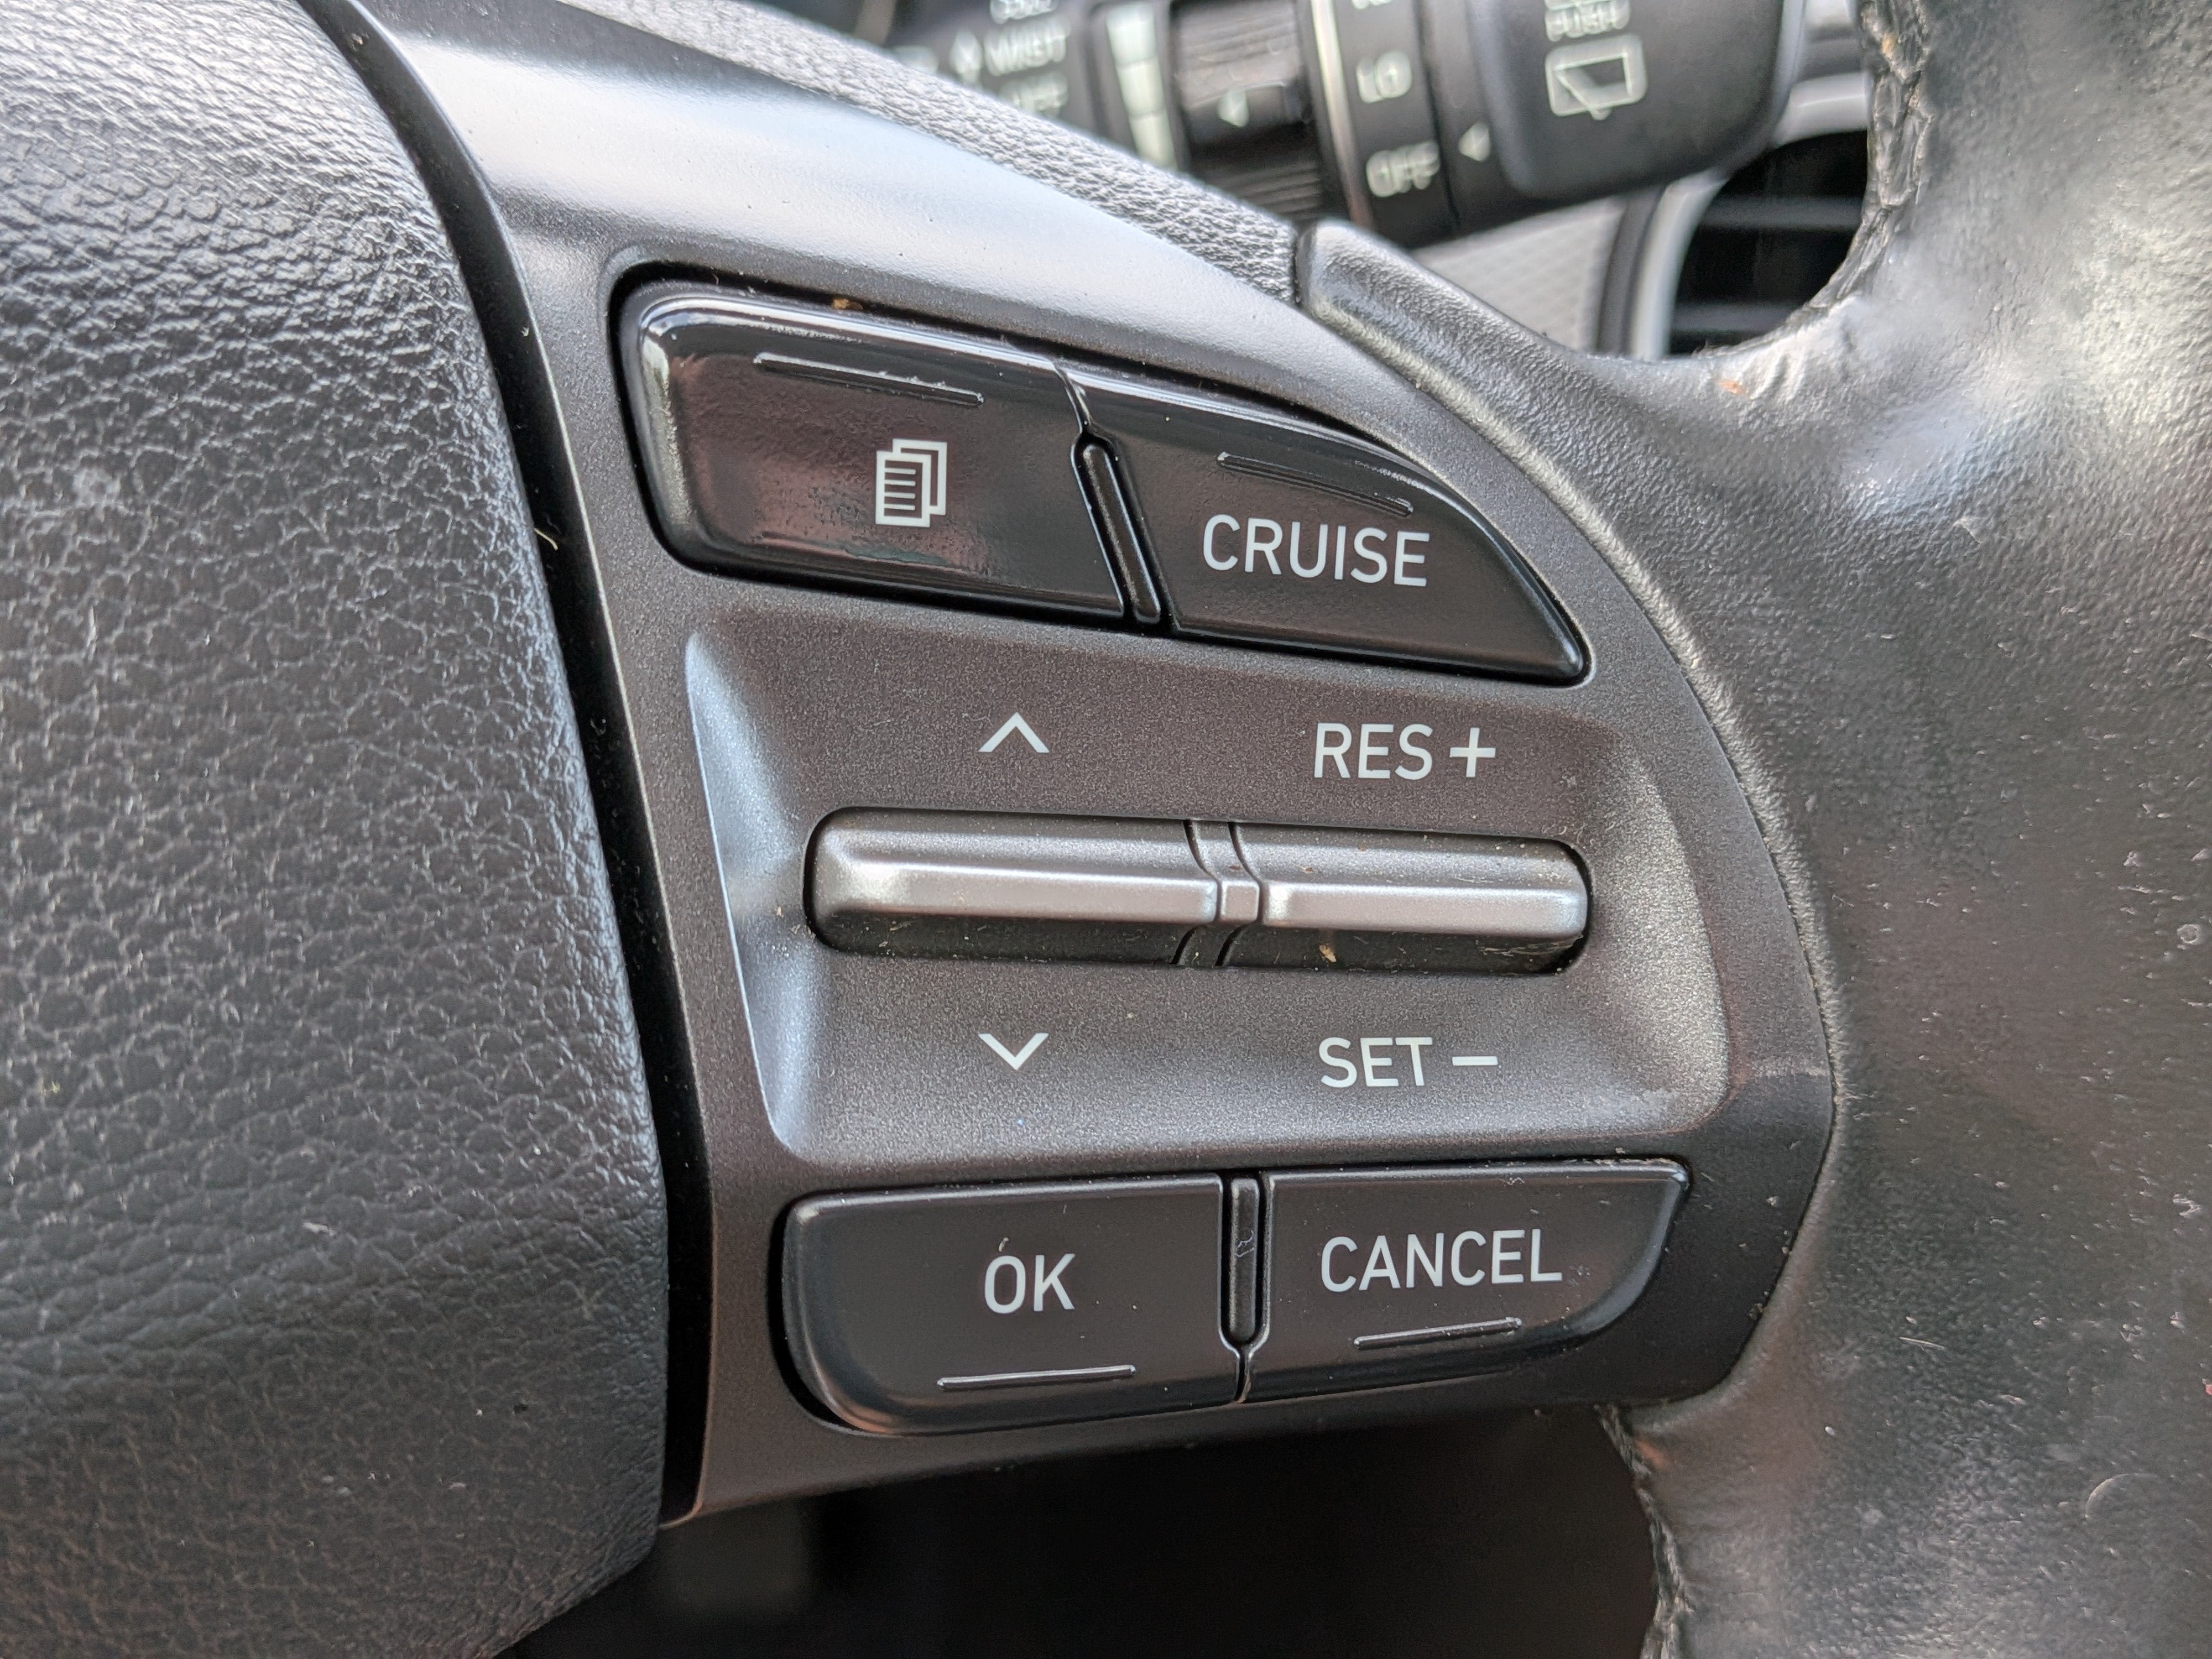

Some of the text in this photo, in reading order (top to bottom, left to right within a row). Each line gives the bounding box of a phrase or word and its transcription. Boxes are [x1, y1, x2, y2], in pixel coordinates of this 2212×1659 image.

[1366, 140, 1440, 198] OFF
[1203, 514, 1430, 587] CRUISE
[1314, 722, 1433, 780] RES
[1318, 1037, 1433, 1088] SET
[984, 1253, 1076, 1314] OK
[1321, 1229, 1562, 1292] CANCEL
